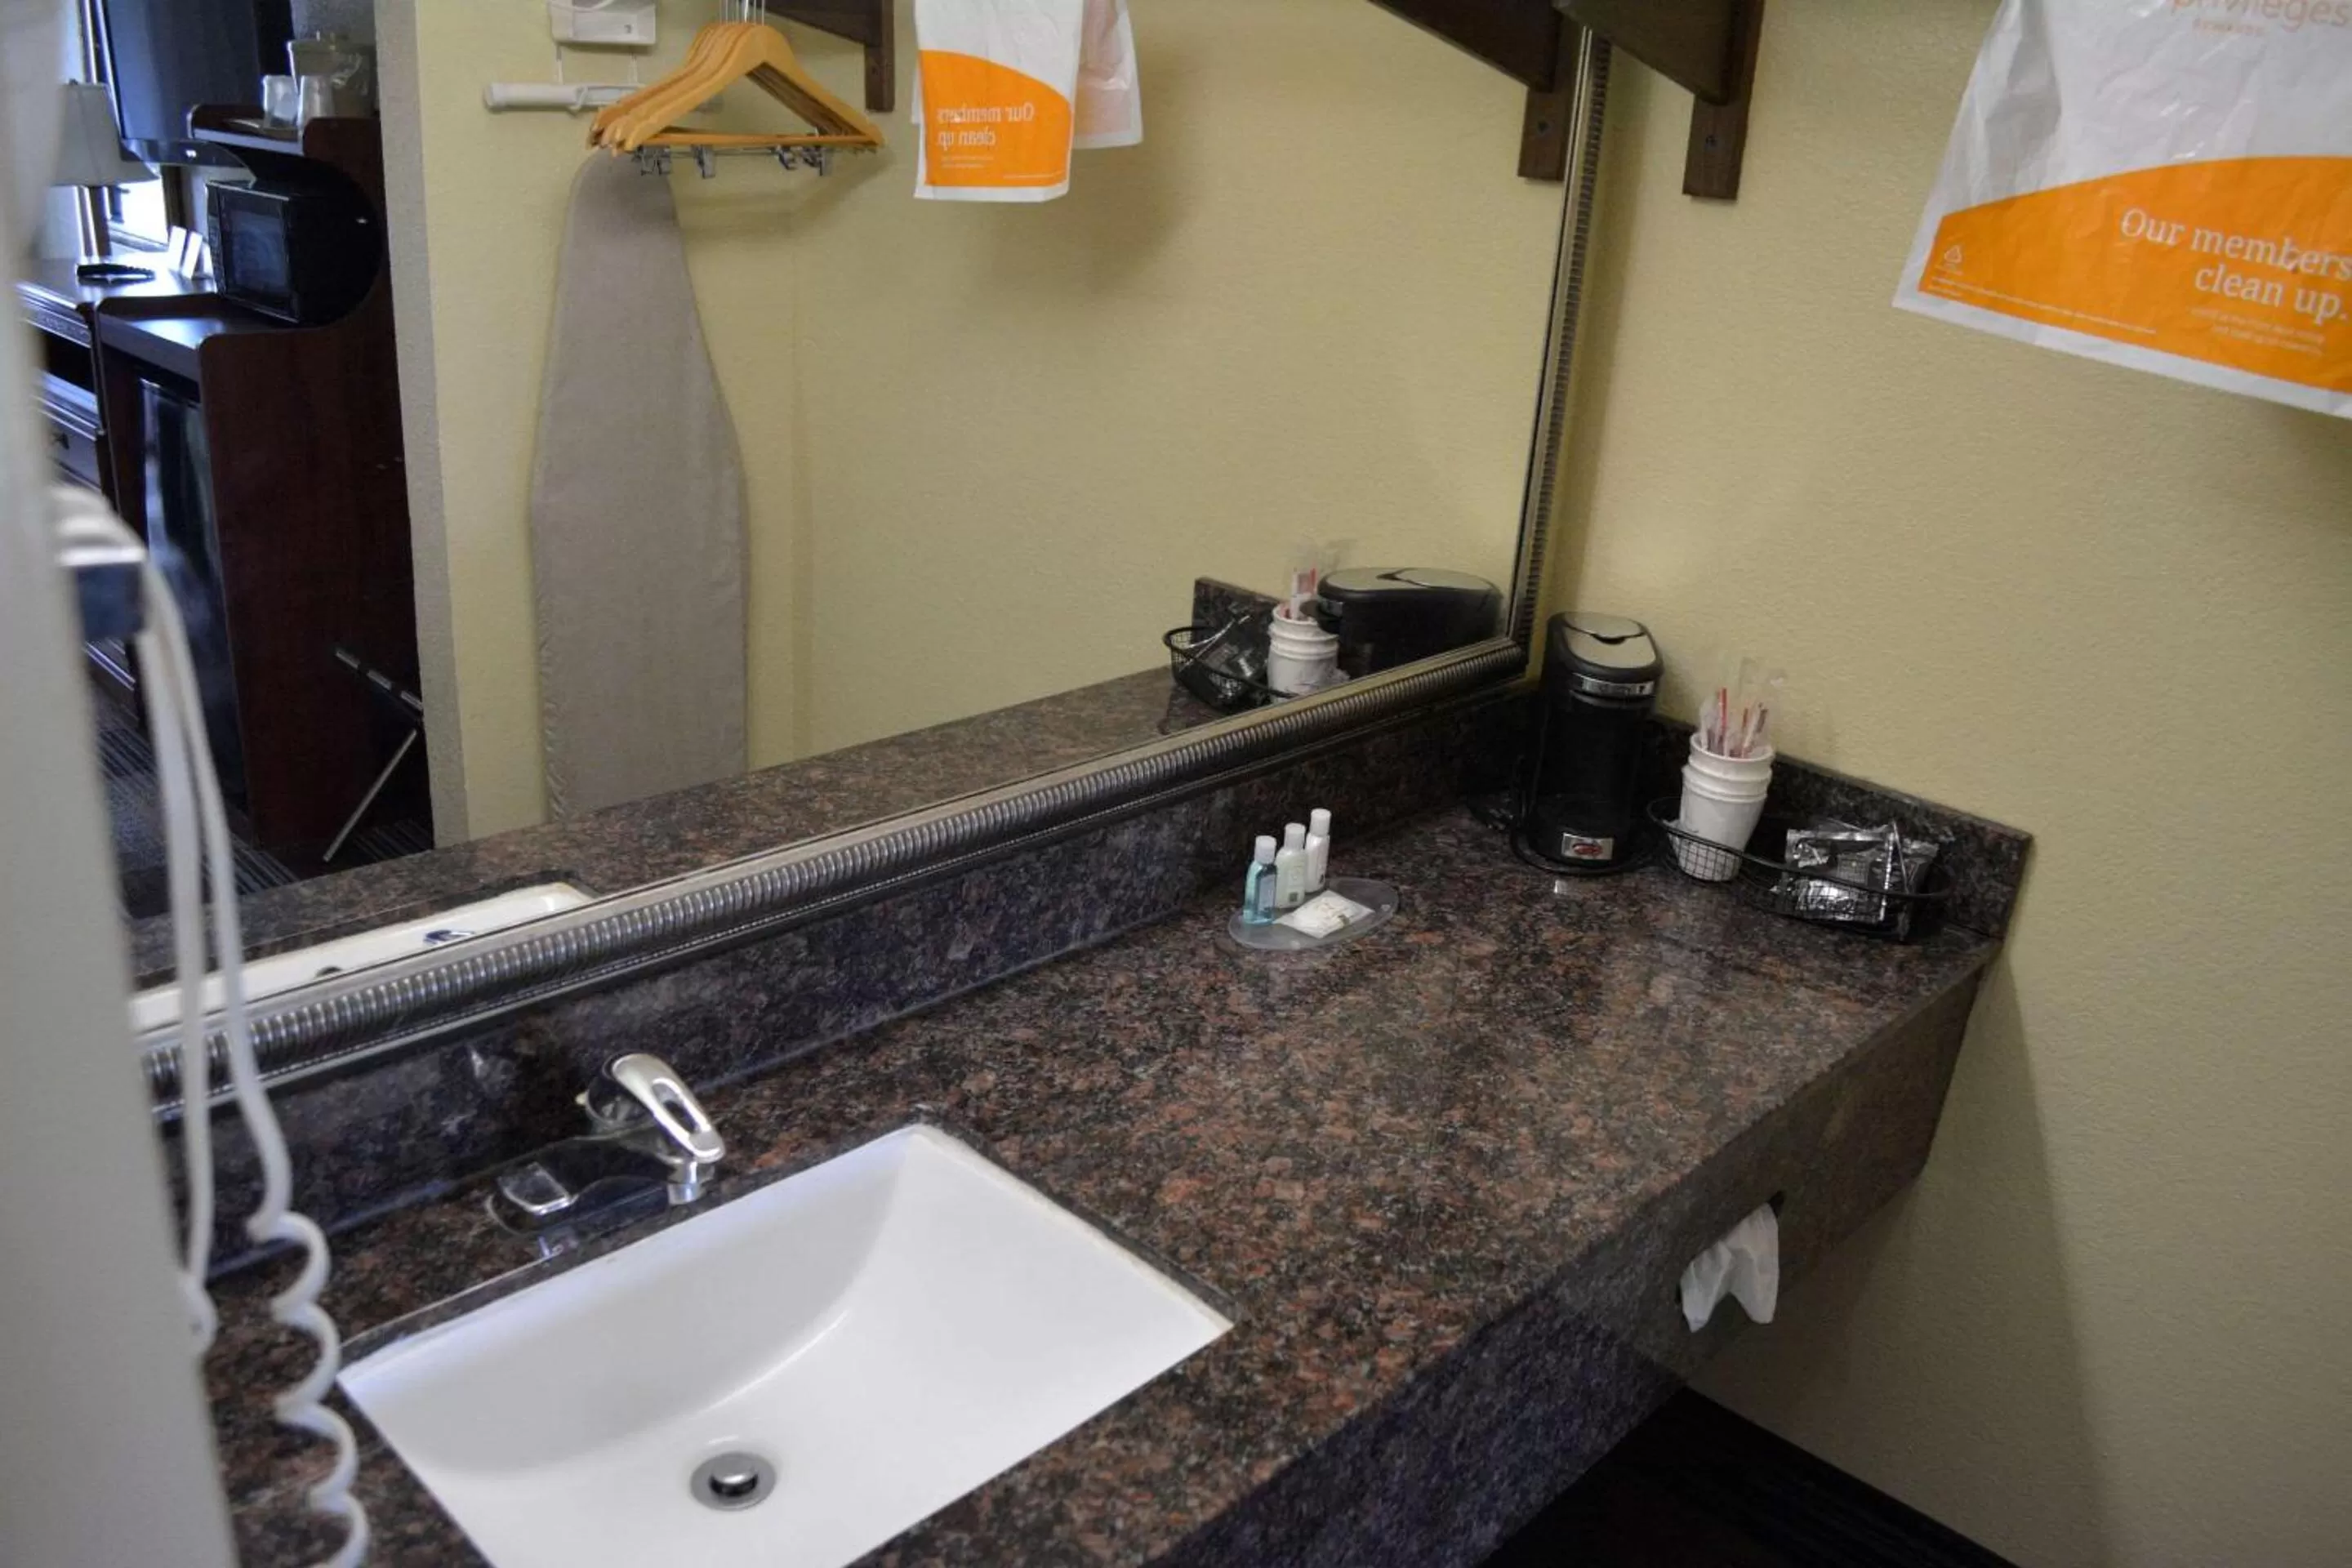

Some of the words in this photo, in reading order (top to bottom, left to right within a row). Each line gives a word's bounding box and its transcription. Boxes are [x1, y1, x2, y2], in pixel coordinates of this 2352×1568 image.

[2169, 0, 2349, 33] pvleges
[2121, 207, 2186, 247] Our
[2190, 226, 2352, 281] members
[2194, 263, 2283, 308] clean
[2293, 287, 2348, 325] up.
